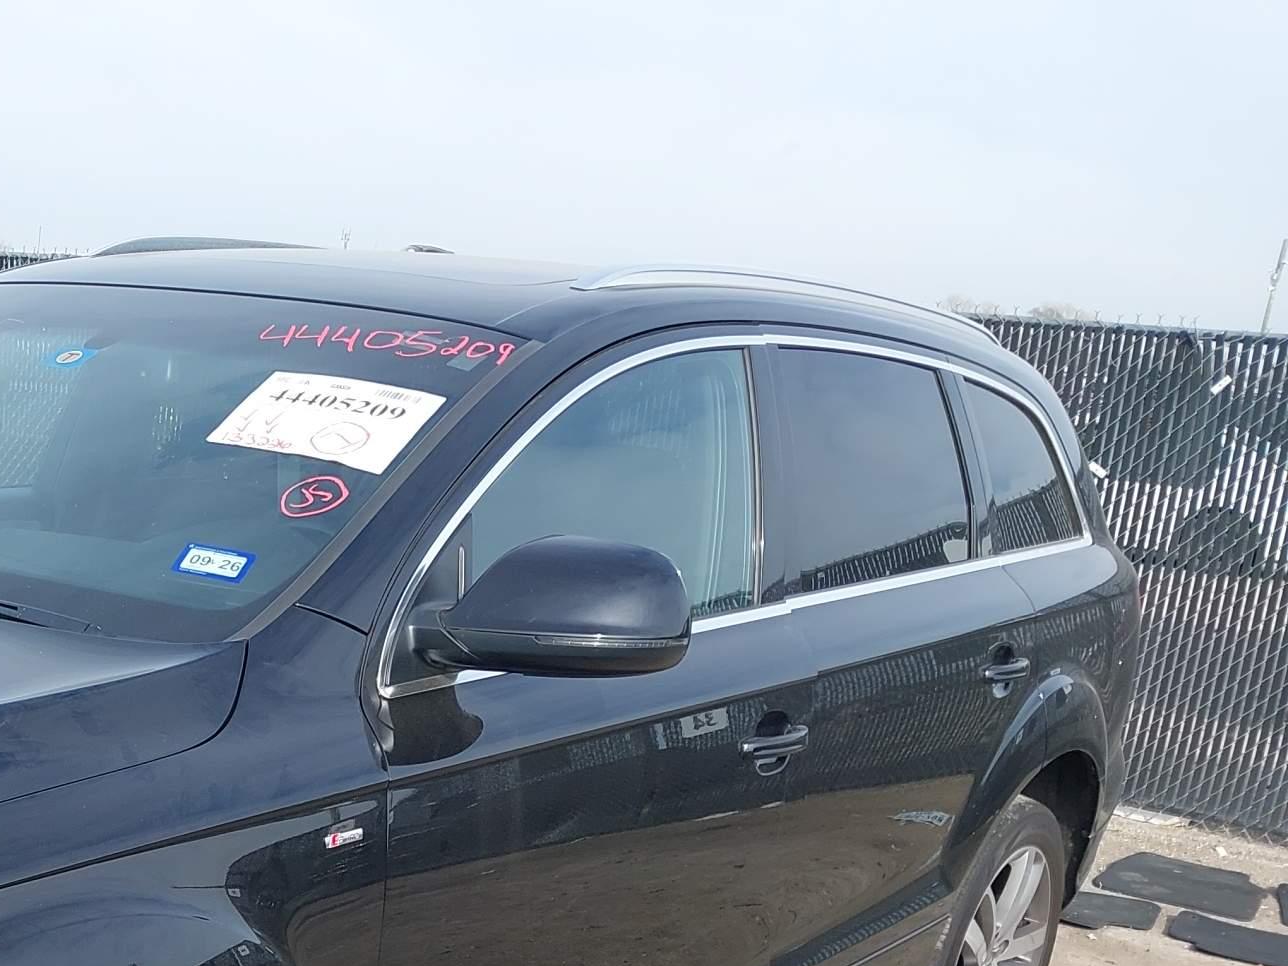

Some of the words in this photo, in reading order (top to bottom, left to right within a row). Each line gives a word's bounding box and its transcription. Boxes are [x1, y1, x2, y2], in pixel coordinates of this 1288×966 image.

[259, 324, 516, 366] 44405209
[268, 389, 407, 420] 44405209
[218, 559, 242, 572] 26
